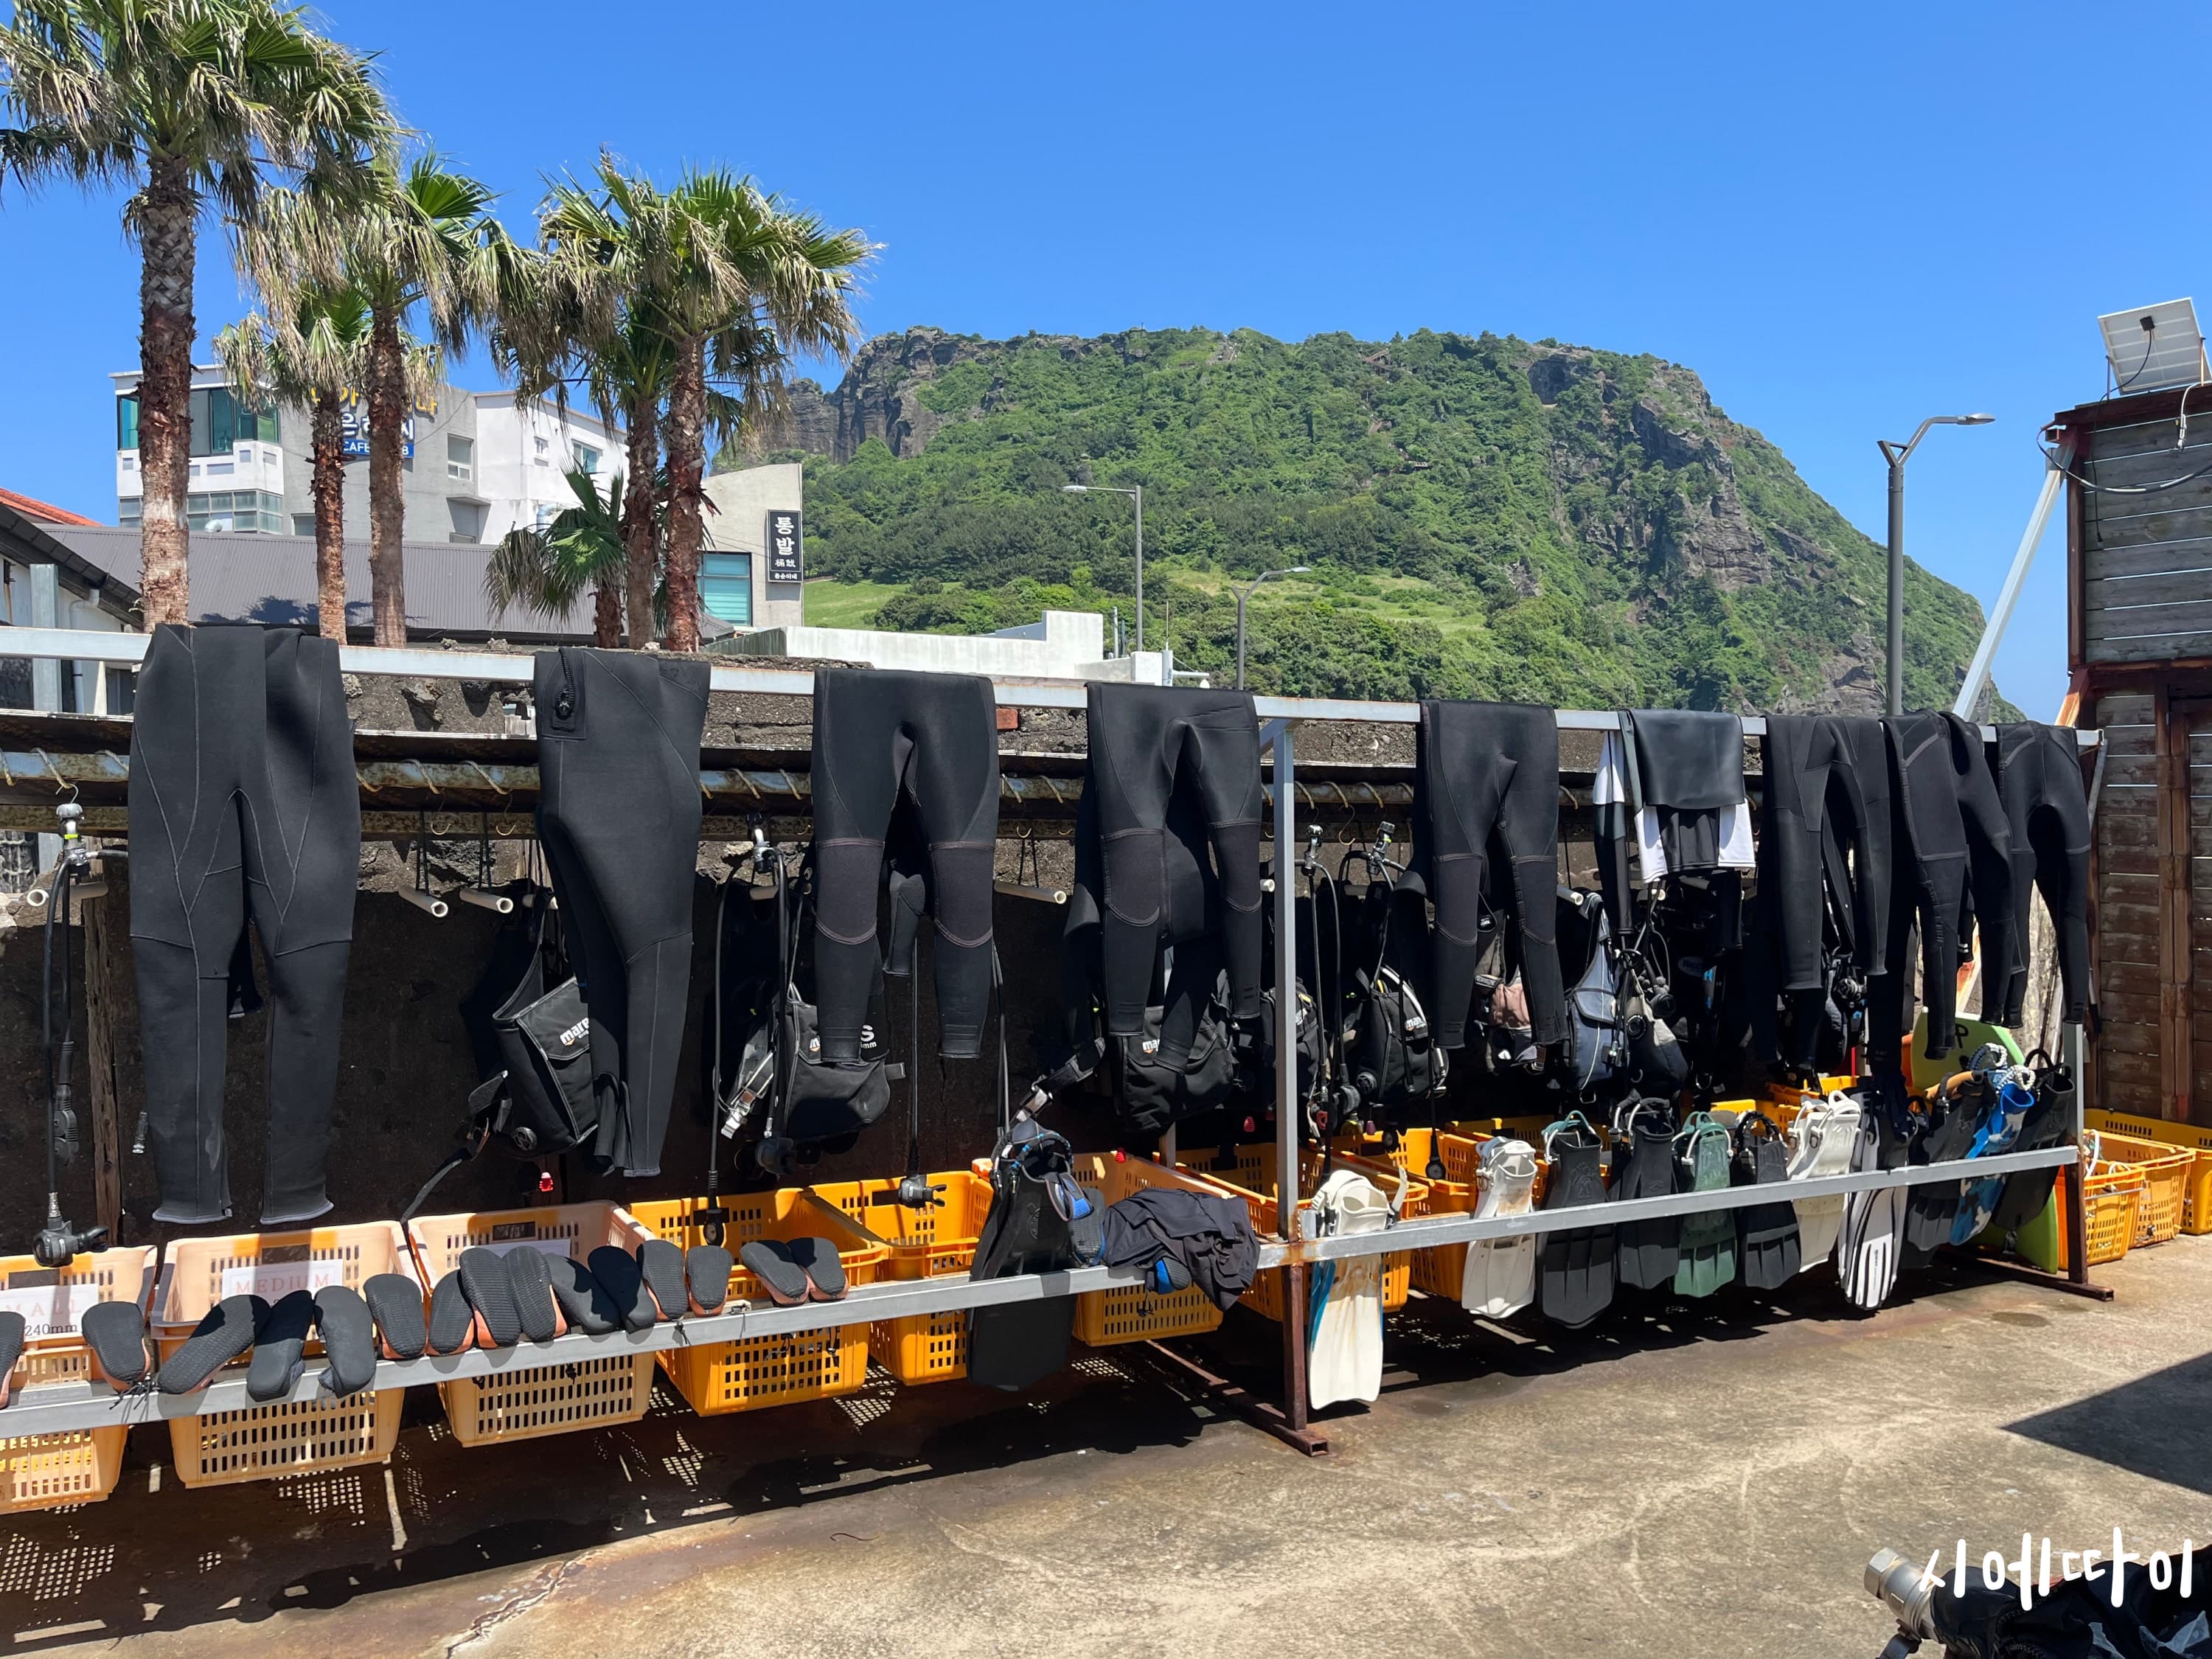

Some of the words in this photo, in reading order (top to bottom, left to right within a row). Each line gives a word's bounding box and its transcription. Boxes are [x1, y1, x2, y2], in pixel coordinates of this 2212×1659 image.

[344, 442, 370, 452] CAFE
[775, 517, 795, 555] 통발
[560, 1018, 589, 1045] mare
[236, 1273, 330, 1294] MEDIUM
